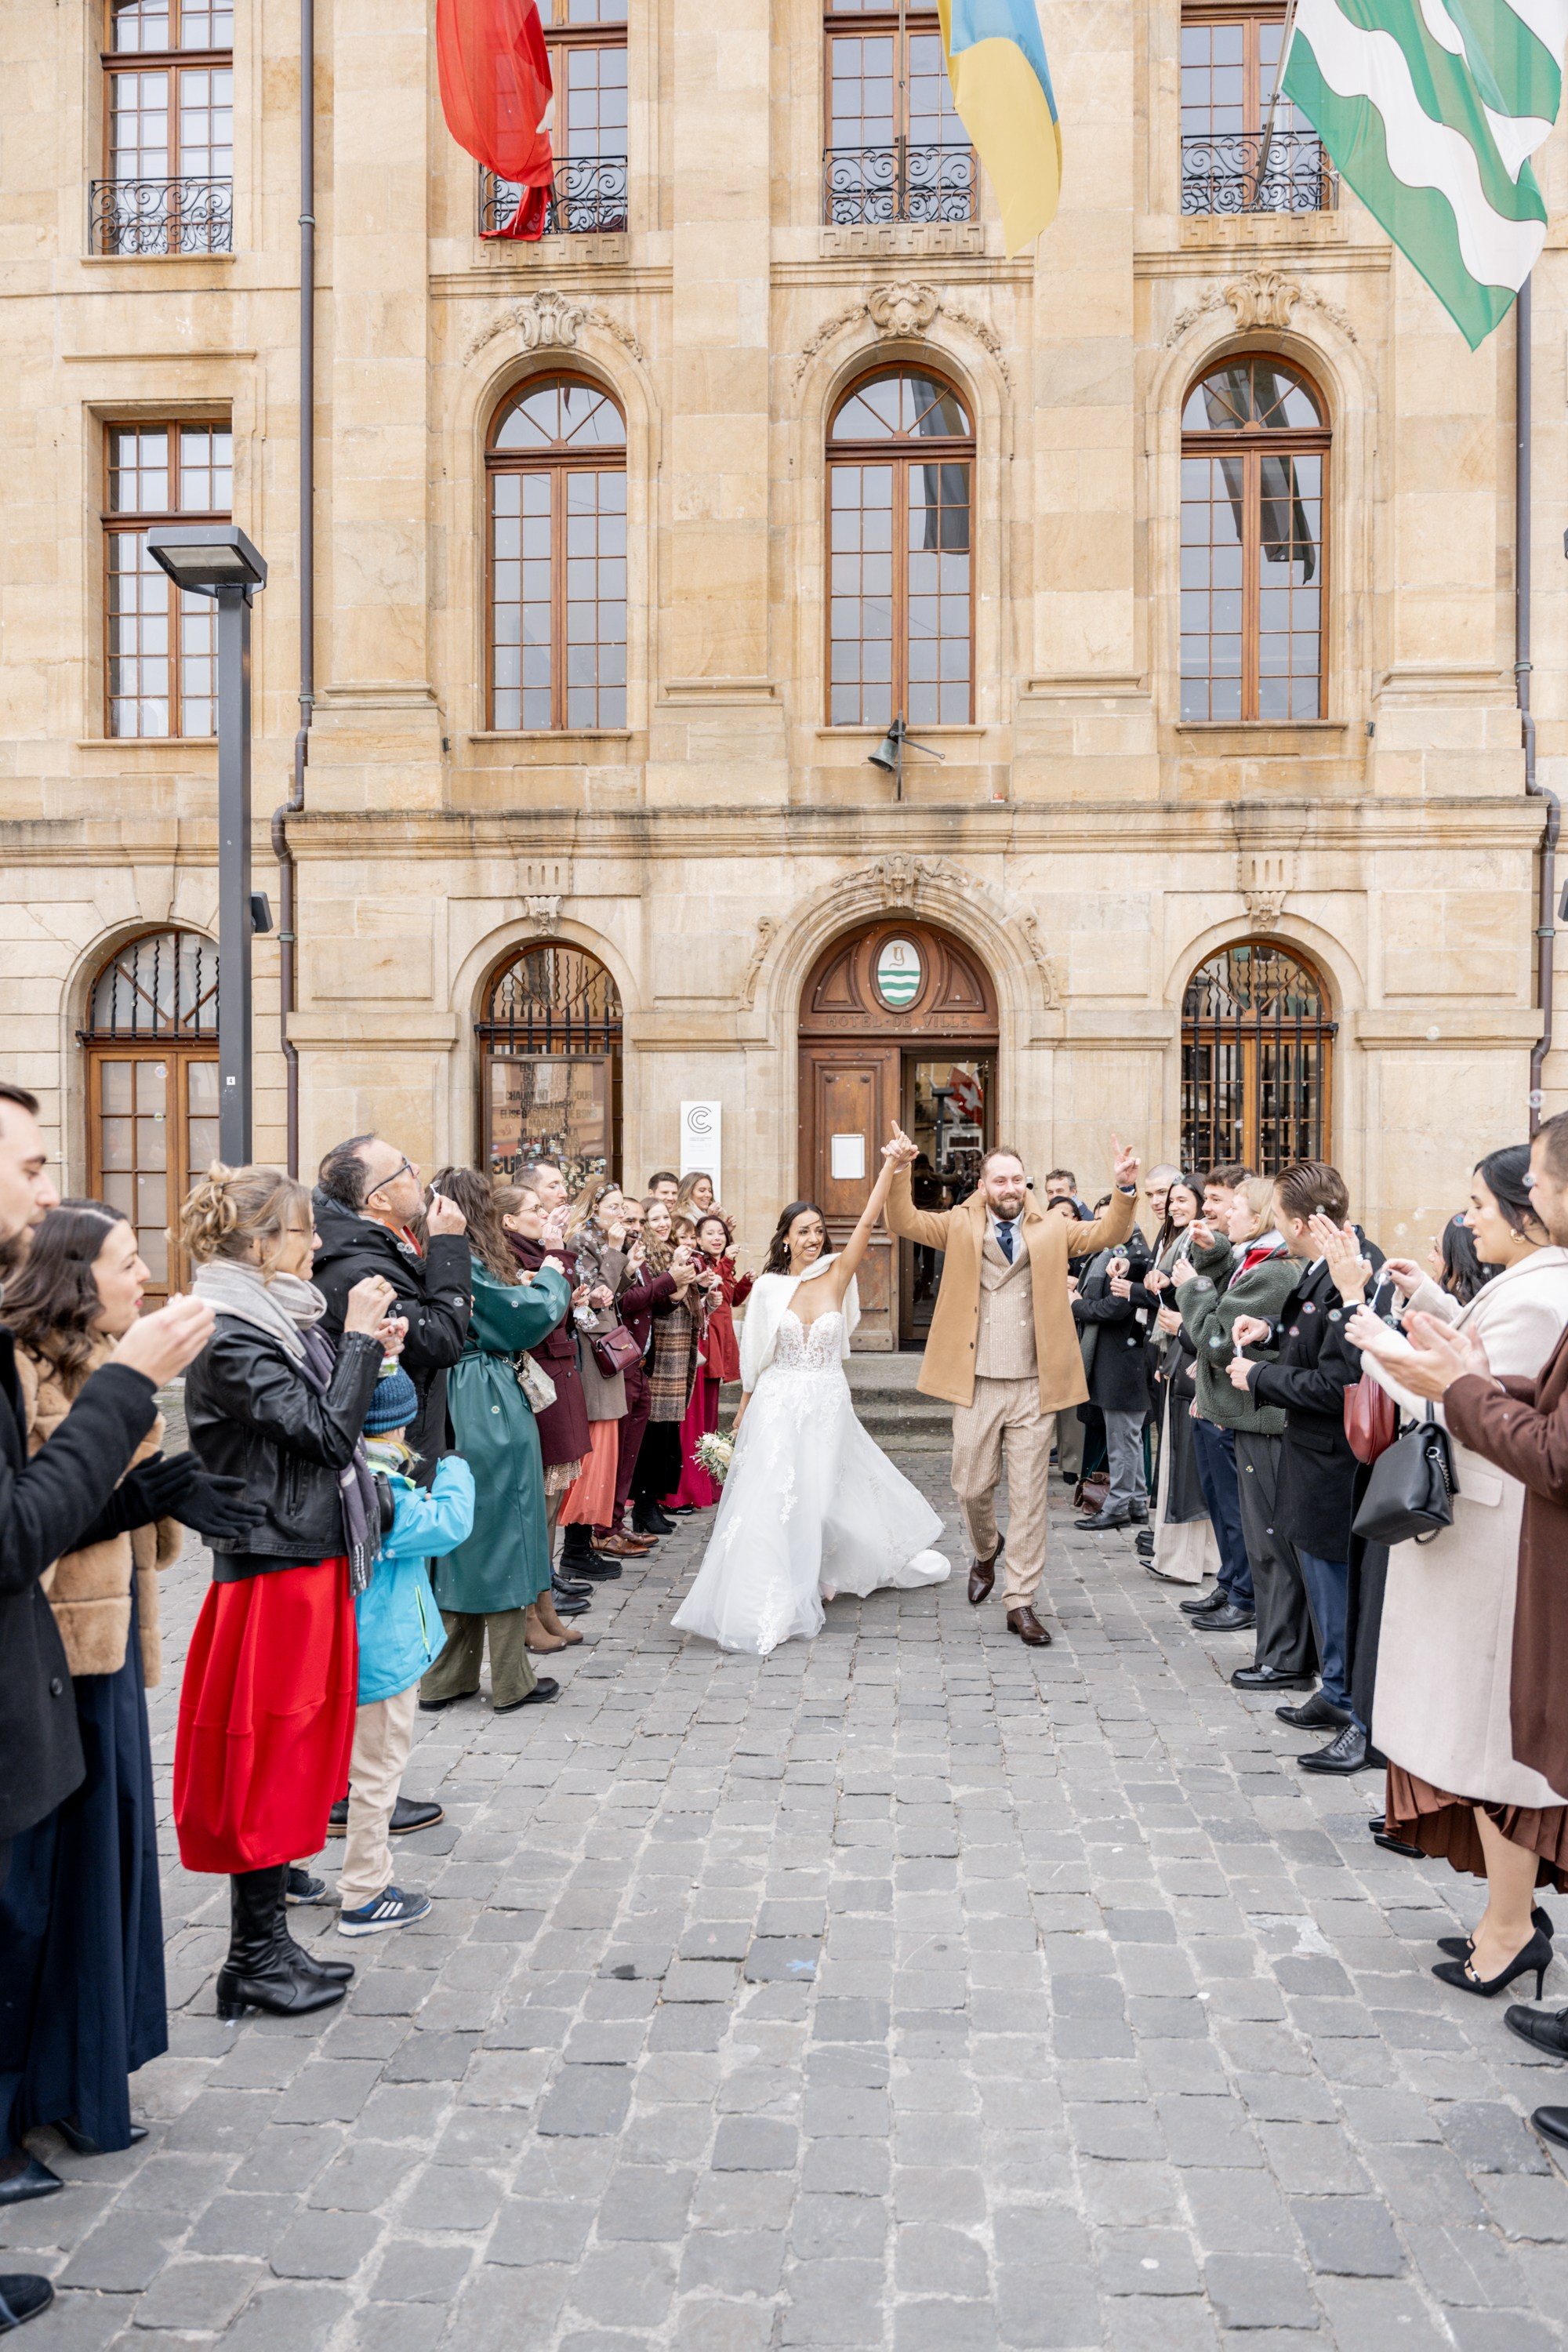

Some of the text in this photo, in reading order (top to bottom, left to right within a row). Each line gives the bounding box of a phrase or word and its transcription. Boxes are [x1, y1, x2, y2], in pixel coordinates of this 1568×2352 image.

[826, 1014, 970, 1028] HOTEL DE VILLE
[500, 1110, 521, 1120] ELISE
